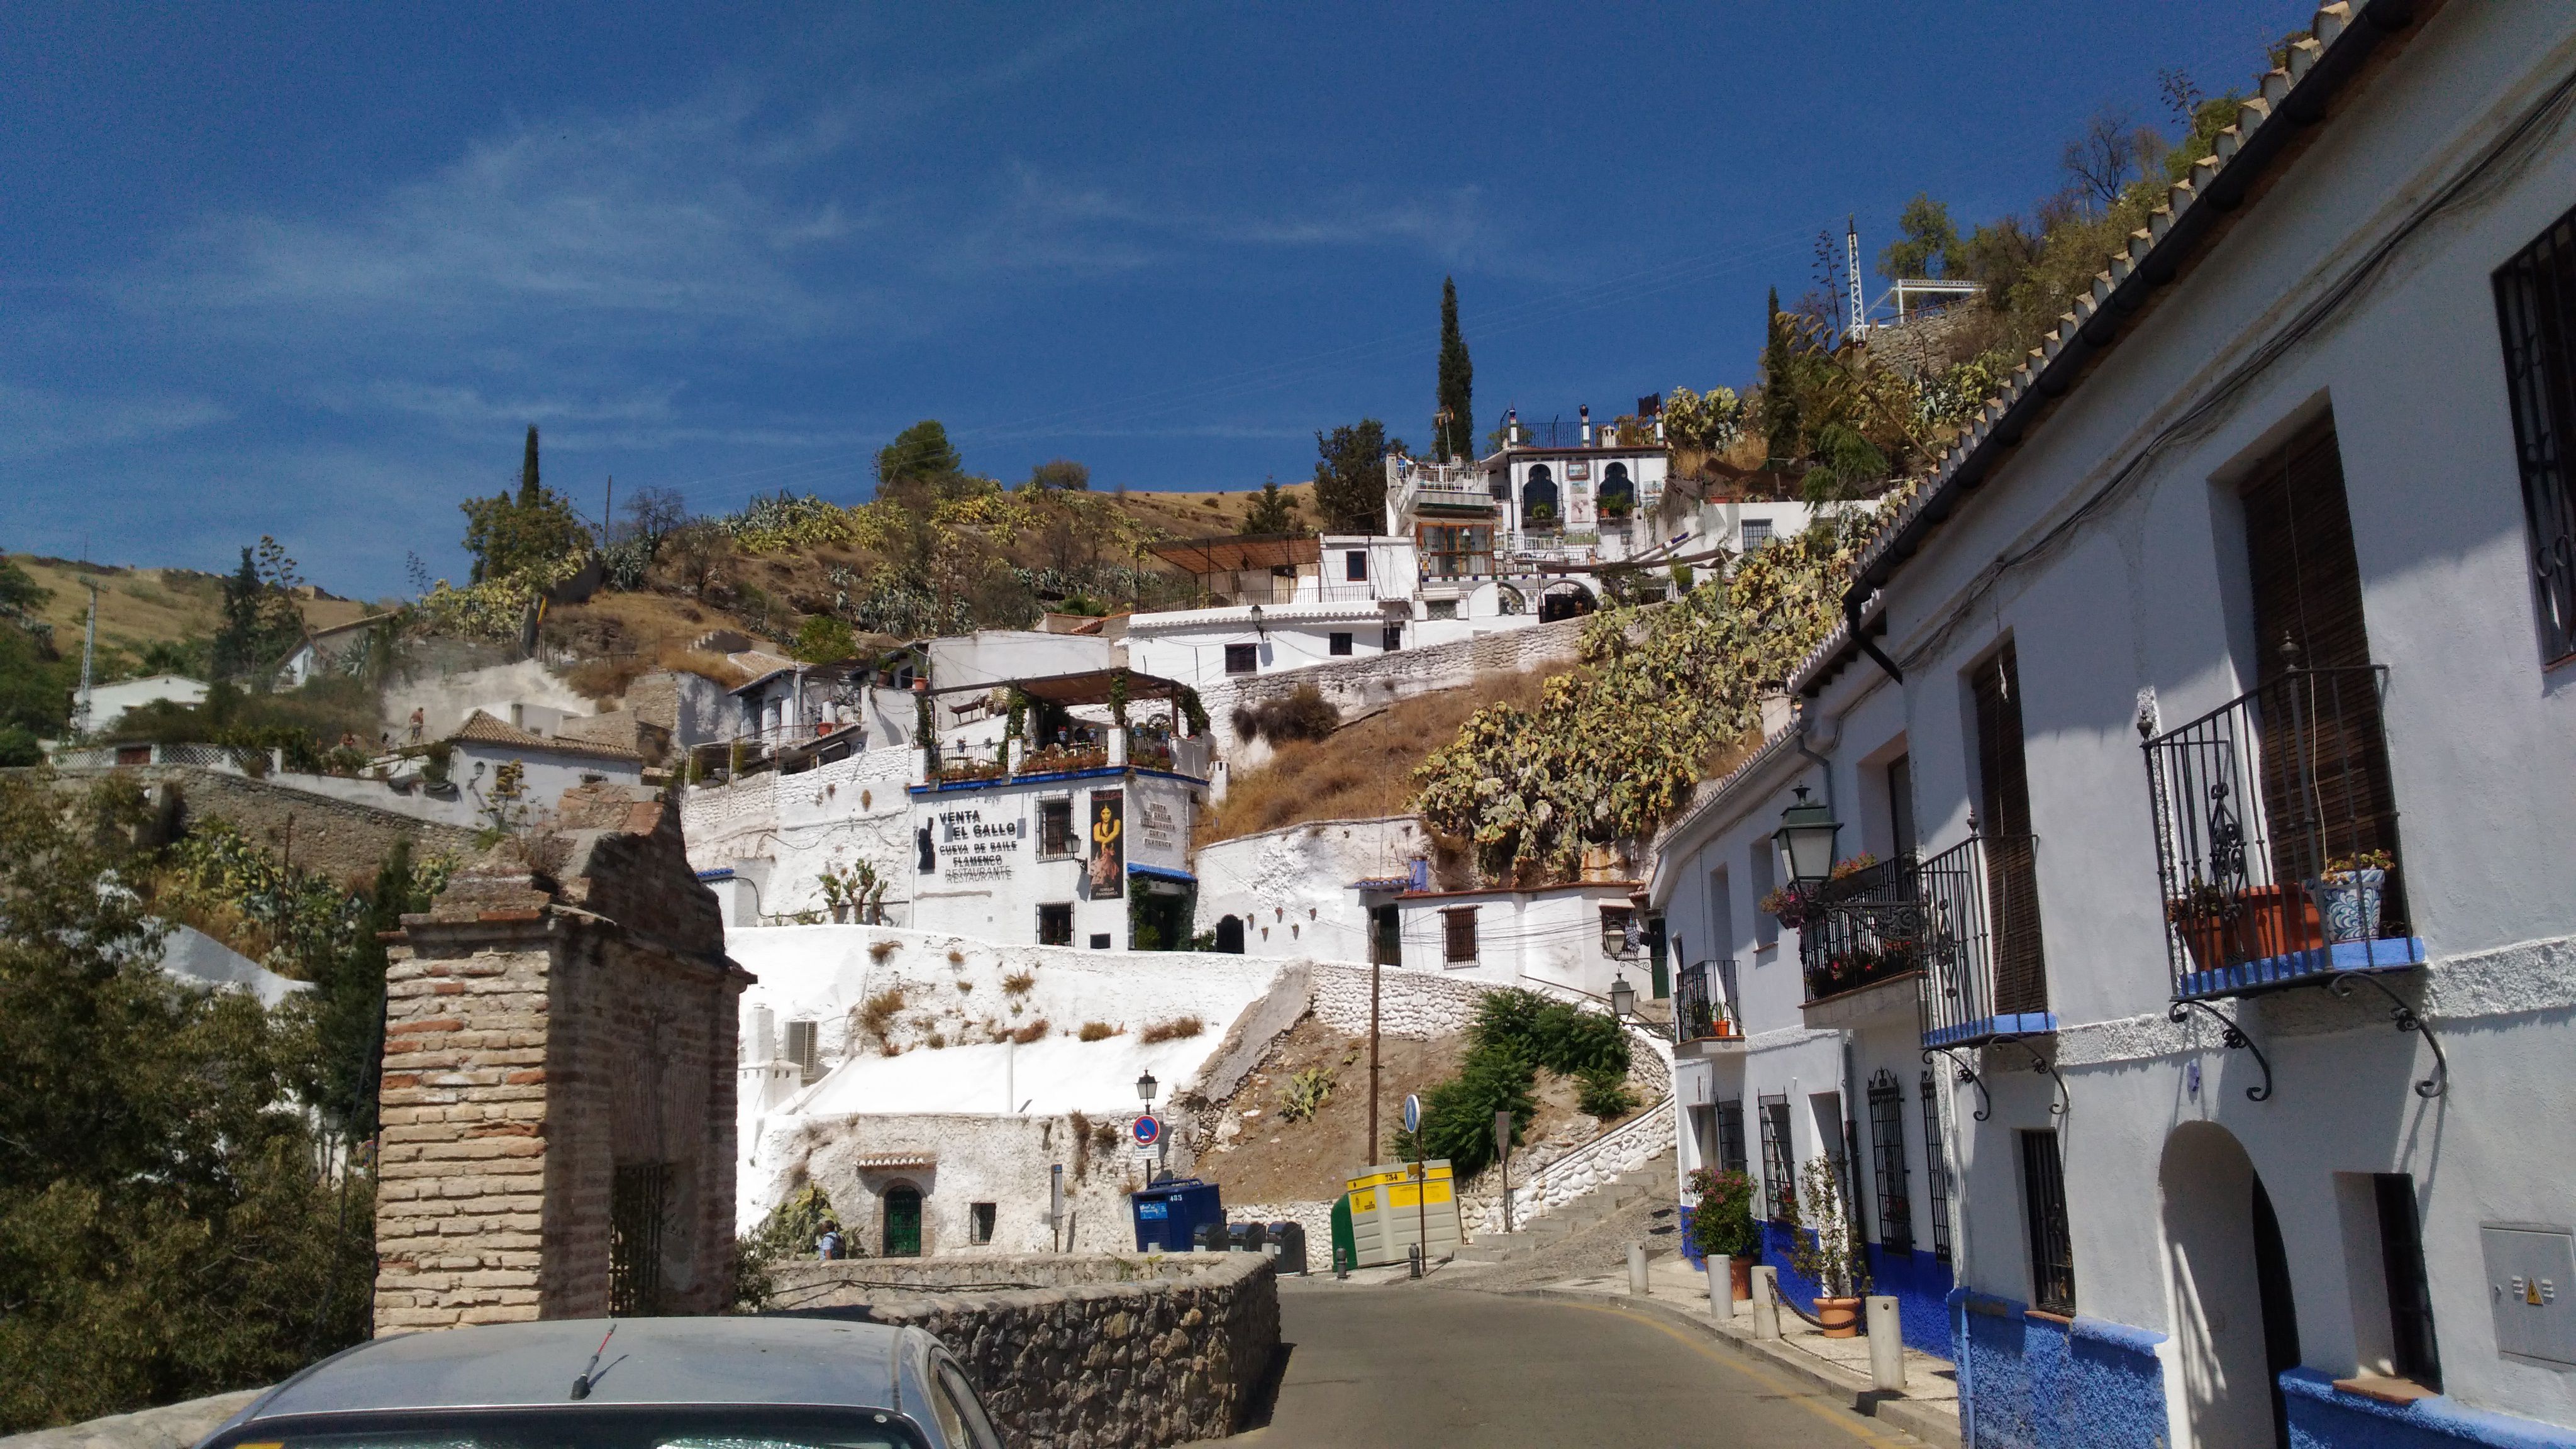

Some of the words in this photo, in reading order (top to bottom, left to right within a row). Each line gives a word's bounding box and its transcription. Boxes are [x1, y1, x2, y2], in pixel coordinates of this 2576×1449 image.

[939, 810, 980, 823] VENTA
[1154, 812, 1171, 820] GALLO
[953, 826, 968, 838] EL
[973, 823, 1016, 836] GALLO
[939, 845, 969, 853] CUEVA
[974, 843, 985, 852] DE
[991, 841, 1017, 850] BAILE
[953, 855, 1002, 865] FLAMENCO
[945, 866, 1011, 880] RESTAURANTE
[1385, 1173, 1398, 1181] 734
